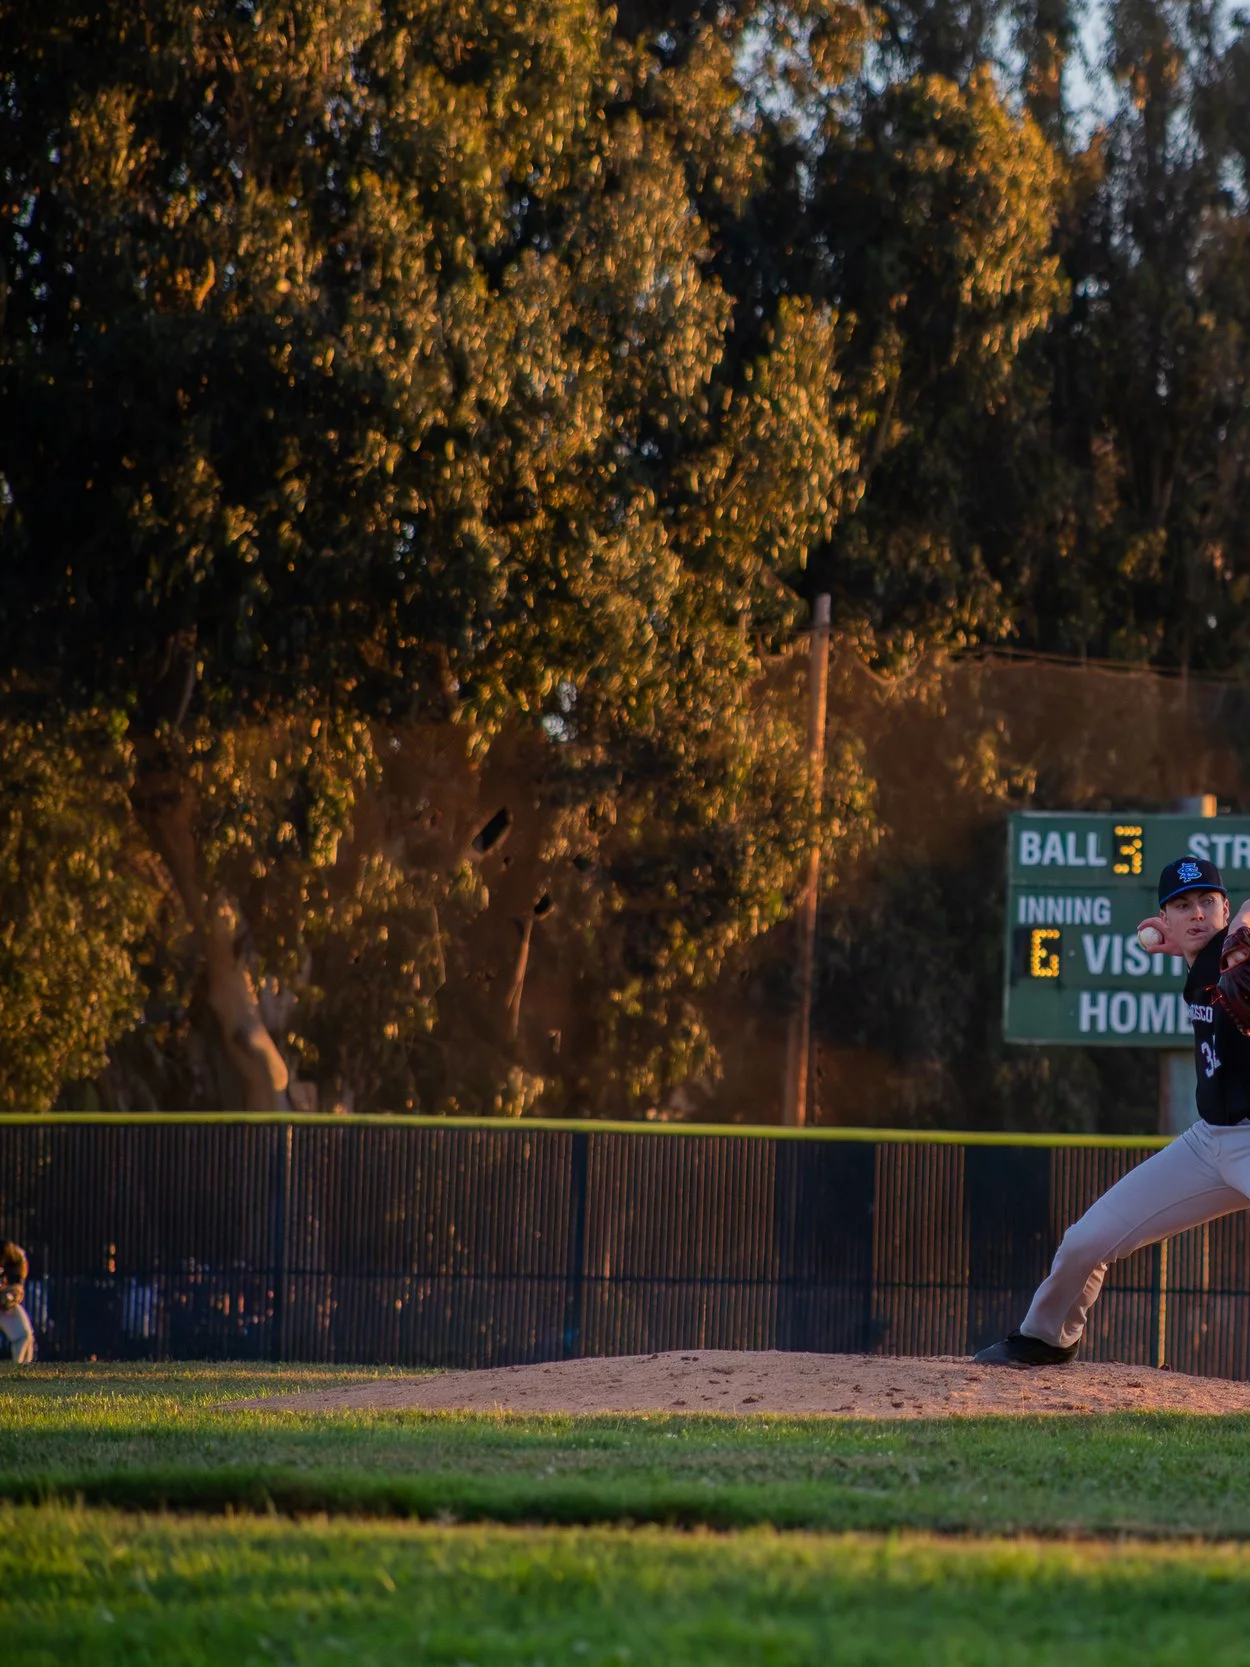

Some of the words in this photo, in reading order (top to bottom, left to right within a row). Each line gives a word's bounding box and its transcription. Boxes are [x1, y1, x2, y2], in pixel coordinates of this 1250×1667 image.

[1019, 831, 1107, 866] BALL
[1113, 826, 1142, 874] 3
[1018, 895, 1111, 925] INNING
[1031, 929, 1060, 977] 6
